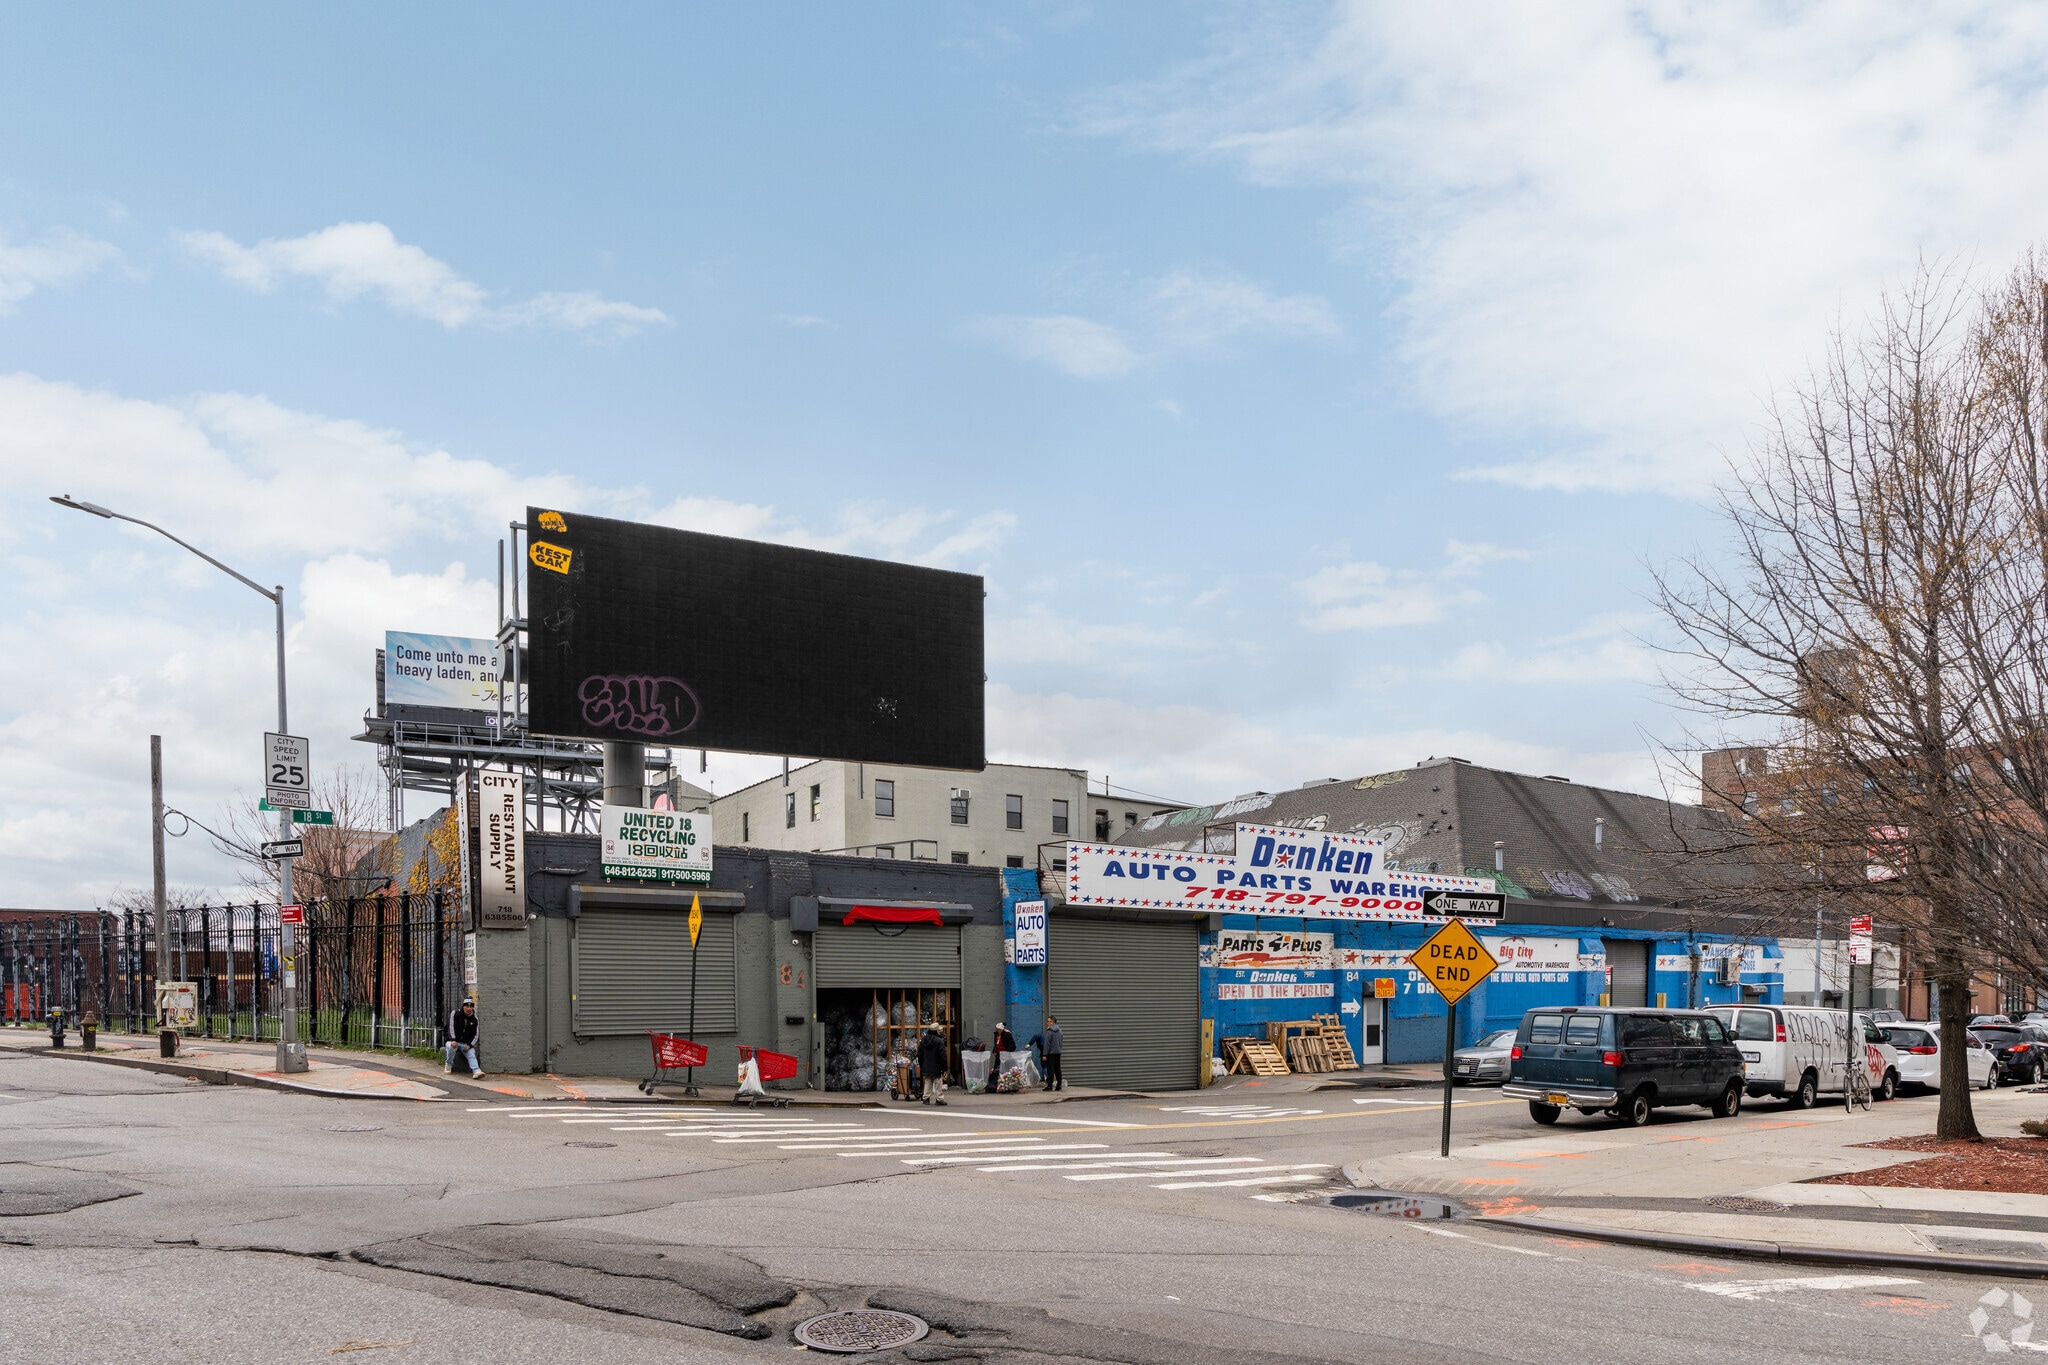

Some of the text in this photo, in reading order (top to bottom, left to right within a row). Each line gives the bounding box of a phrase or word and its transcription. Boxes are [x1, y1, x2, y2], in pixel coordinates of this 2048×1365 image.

[535, 545, 570, 562] KEST
[536, 554, 563, 569] GAK
[396, 645, 431, 661] Come
[437, 651, 463, 664] unto
[468, 655, 486, 666] me
[396, 662, 432, 681] heavy
[437, 665, 475, 682] laden,
[277, 737, 295, 746] CITY
[273, 746, 299, 755] SPEED
[276, 755, 297, 763] LIMIT
[272, 764, 304, 785] 25
[483, 776, 518, 788] CITY
[270, 797, 306, 806] ENFORCED
[303, 812, 312, 822] 18
[623, 812, 692, 831] UNITED 18
[489, 813, 501, 870] SUPPLY
[503, 793, 516, 893] RESTAURANT
[620, 827, 696, 845] RECYCLING
[266, 844, 299, 855] ONE WAY
[628, 844, 688, 859] 18回收站
[1250, 836, 1373, 875] Danken
[604, 866, 711, 881] 646-812-6235 917-500-5968
[1103, 860, 1197, 882] AUTO
[1217, 869, 1312, 892] PARTS
[1184, 886, 1422, 911] 718-797-9000
[1435, 899, 1494, 911] ONE WAY
[498, 905, 513, 913] 718
[1017, 915, 1044, 930] AUTO
[1222, 937, 1322, 952] PARTS PLUS
[1017, 948, 1045, 962] PARTS
[1431, 944, 1478, 961] DEAD
[1499, 946, 1534, 960] Big City
[1250, 970, 1298, 983] Danken
[1346, 971, 1359, 982] 84
[1436, 966, 1470, 981] END
[1218, 985, 1330, 998] OPEN TO THE PUBLIC
[1376, 987, 1394, 997] ENTER
[1403, 983, 1411, 994] 7
